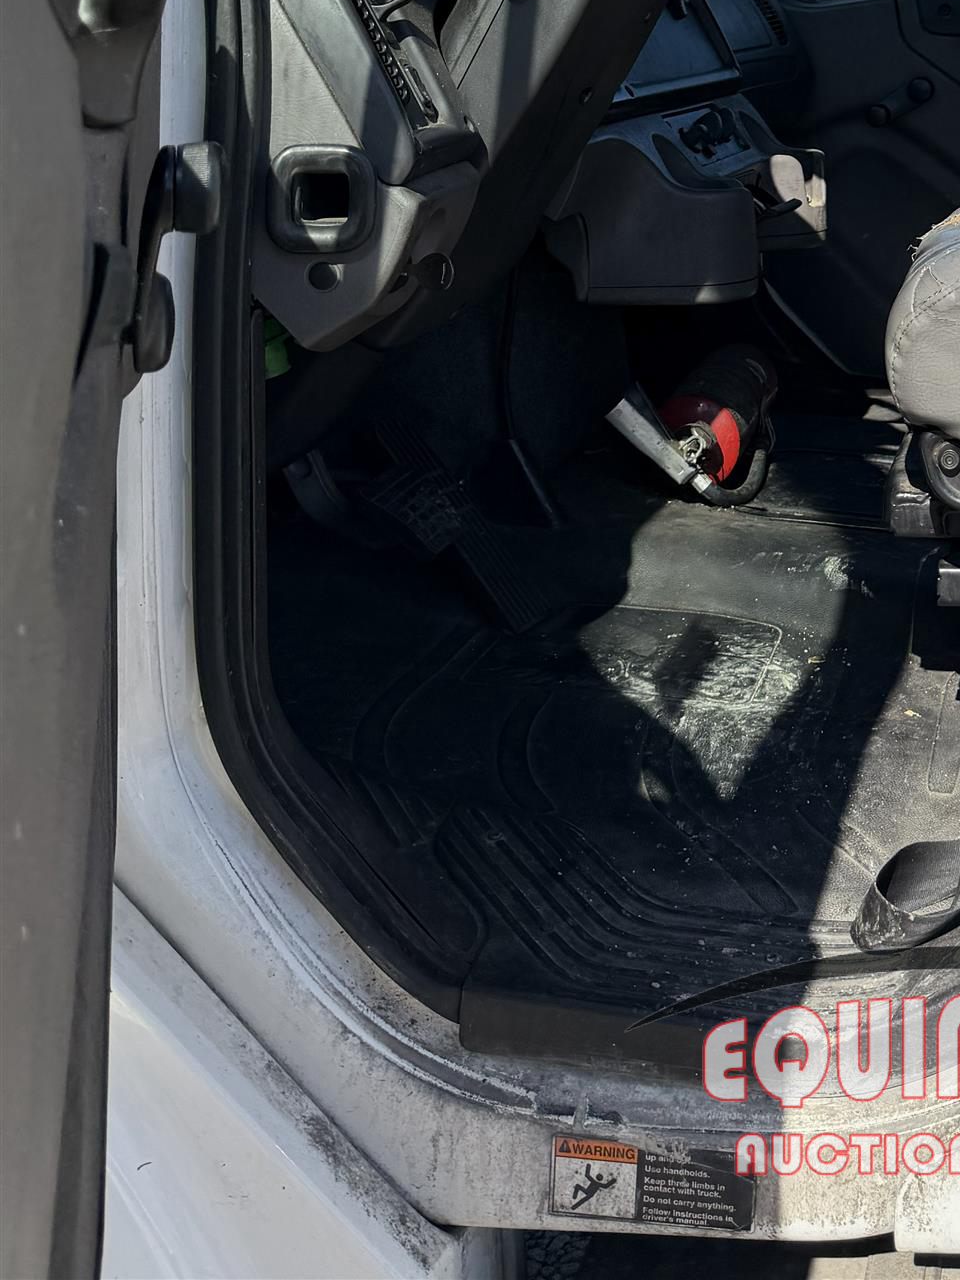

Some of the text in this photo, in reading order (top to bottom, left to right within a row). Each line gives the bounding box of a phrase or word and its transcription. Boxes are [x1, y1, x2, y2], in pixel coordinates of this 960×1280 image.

[572, 1143, 635, 1160] WARNING
[643, 1184, 676, 1194] contact
[677, 1187, 695, 1195] with
[691, 1180, 715, 1190] limbs
[643, 1195, 655, 1203] Do
[657, 1197, 671, 1205] not
[673, 1199, 695, 1209] carry
[642, 1206, 671, 1216] Follow
